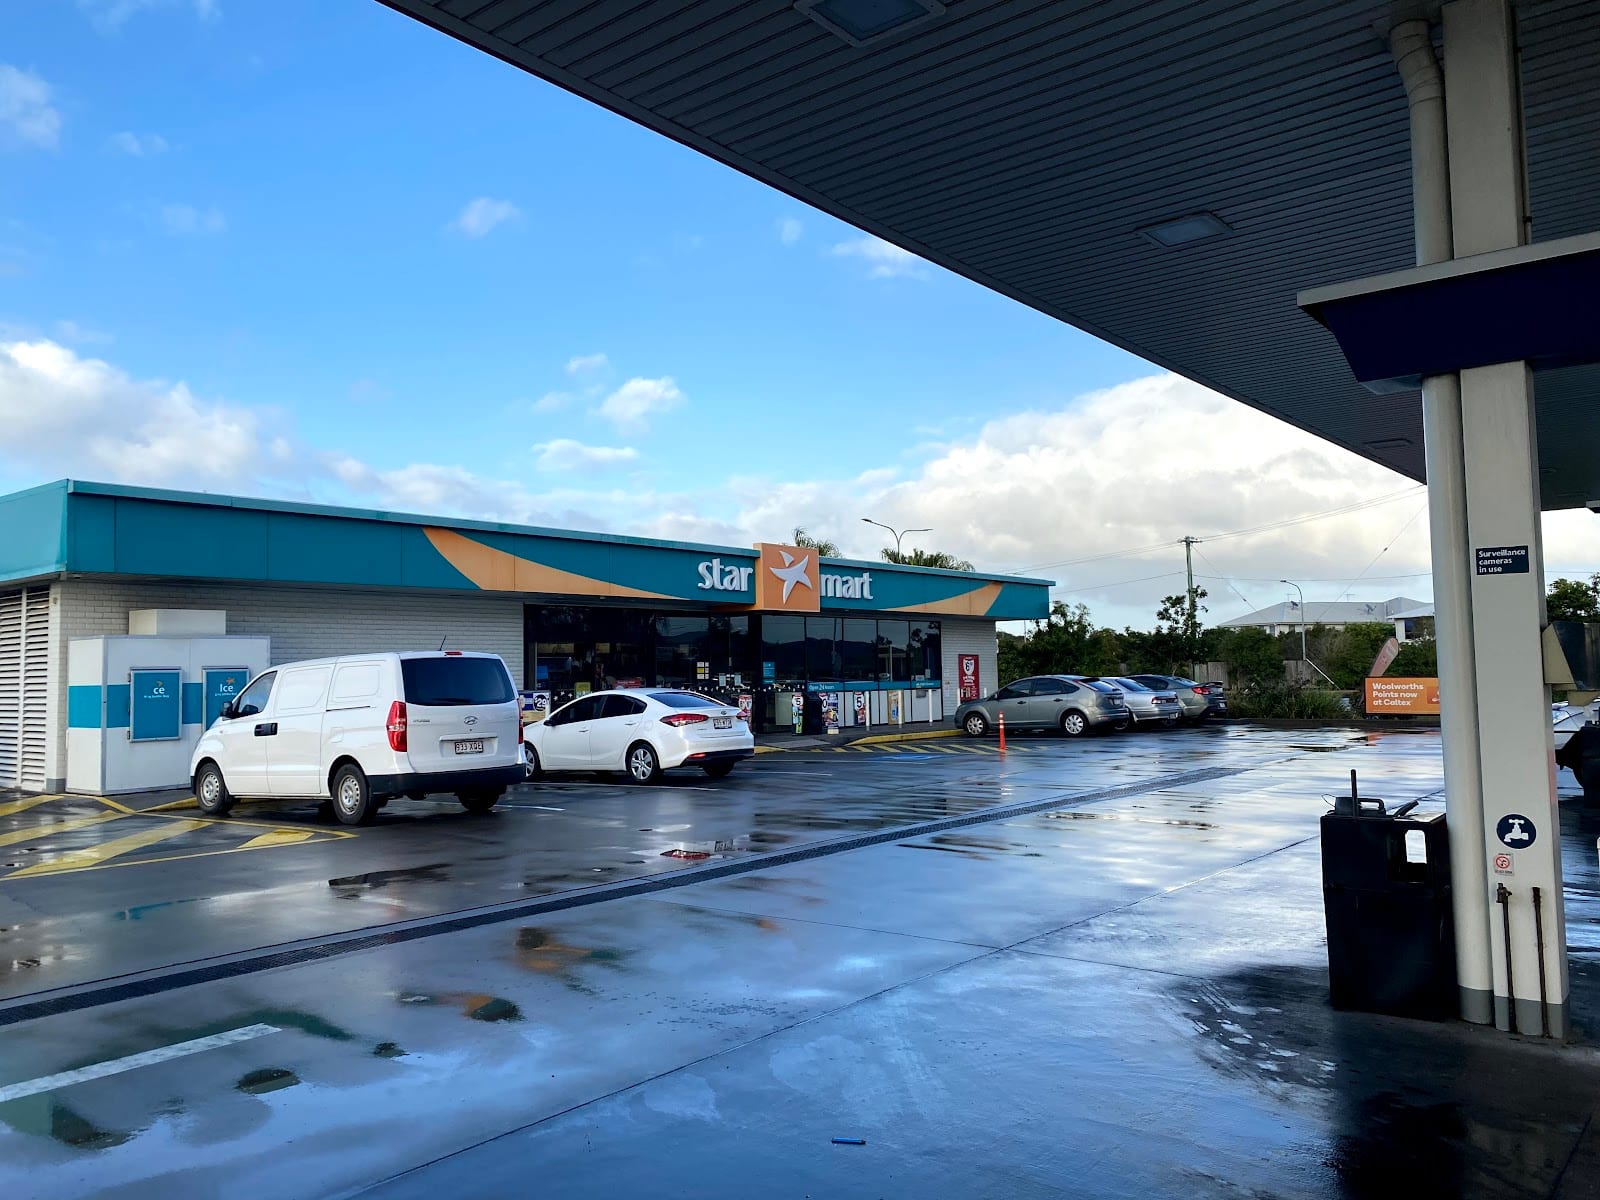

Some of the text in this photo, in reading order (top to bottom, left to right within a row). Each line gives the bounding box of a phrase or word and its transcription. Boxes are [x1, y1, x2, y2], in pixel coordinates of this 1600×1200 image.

[1478, 549, 1526, 558] Surveillance
[697, 558, 874, 600] star mart
[219, 683, 234, 692] Ice
[819, 683, 825, 691] 24
[1372, 682, 1424, 690] Woolworths
